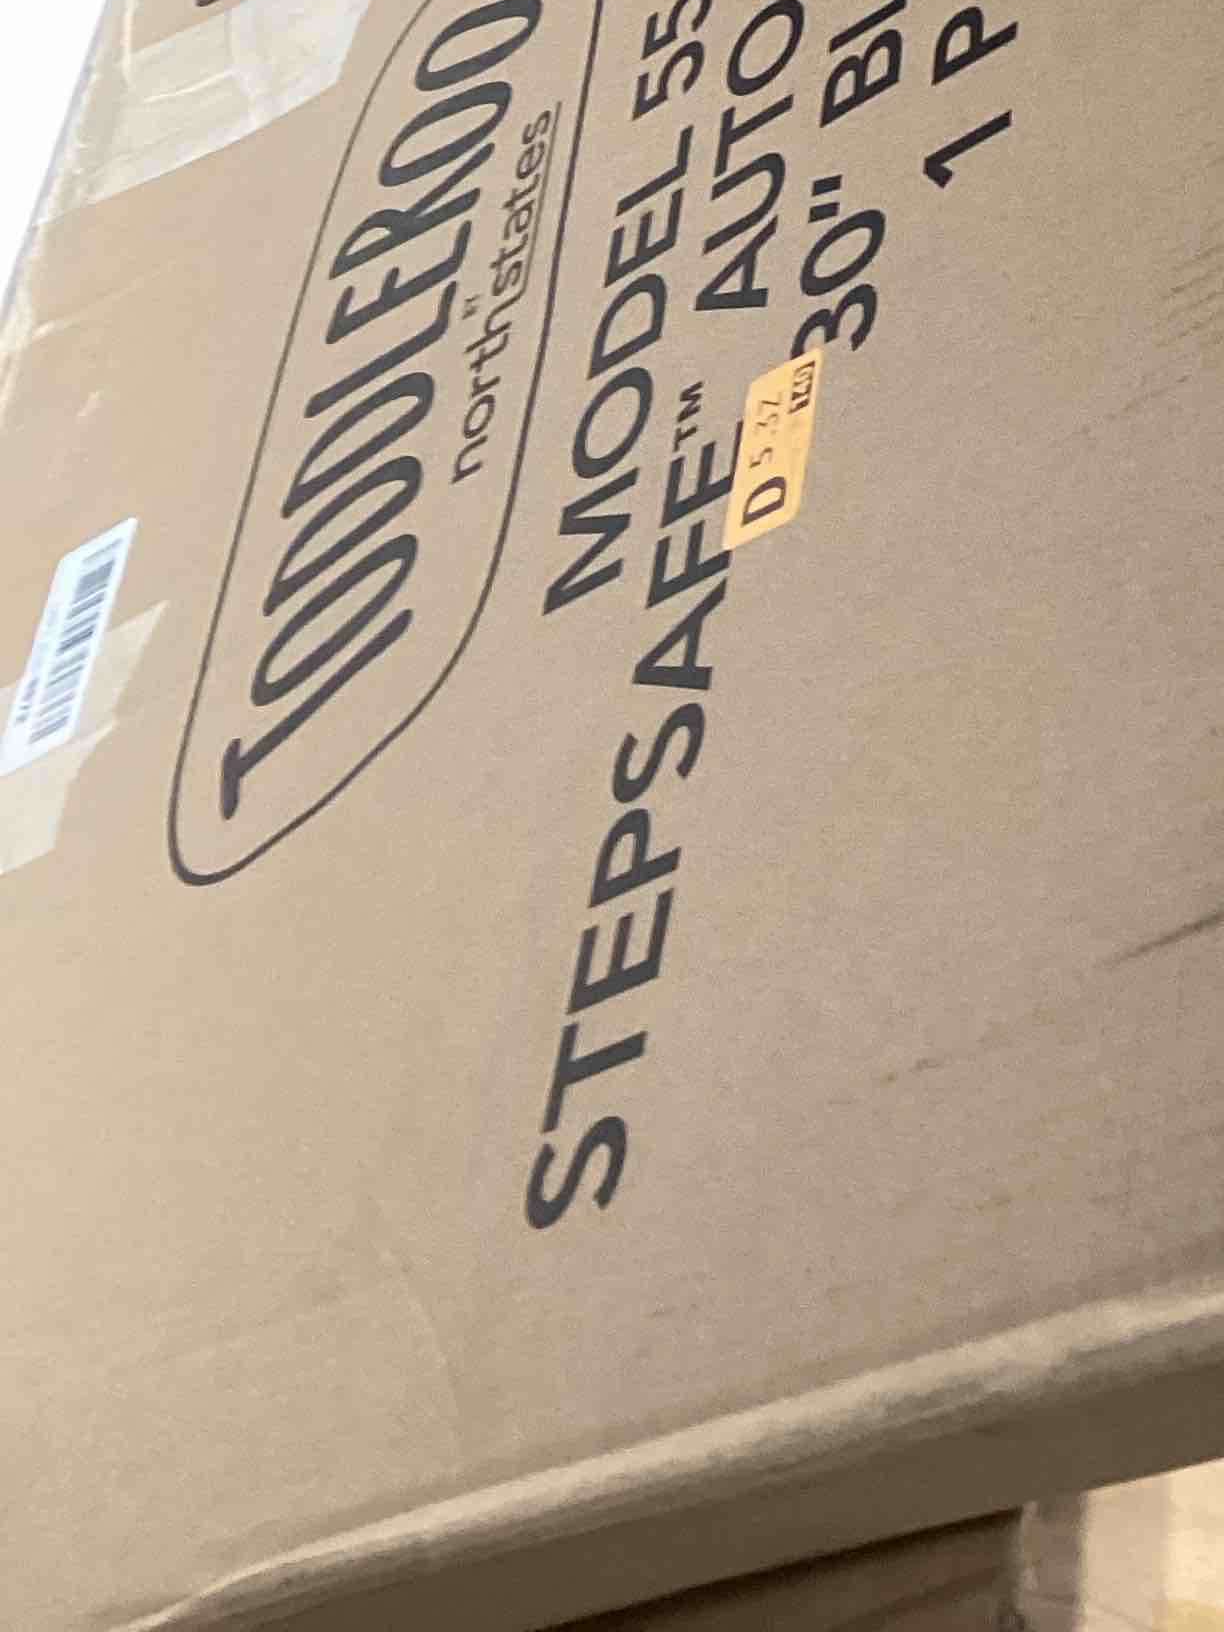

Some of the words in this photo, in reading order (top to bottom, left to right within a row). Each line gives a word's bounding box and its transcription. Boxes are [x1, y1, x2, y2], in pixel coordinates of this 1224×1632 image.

[923, 110, 1012, 189] 1
[542, 125, 694, 616] MODEL
[741, 476, 787, 526] D
